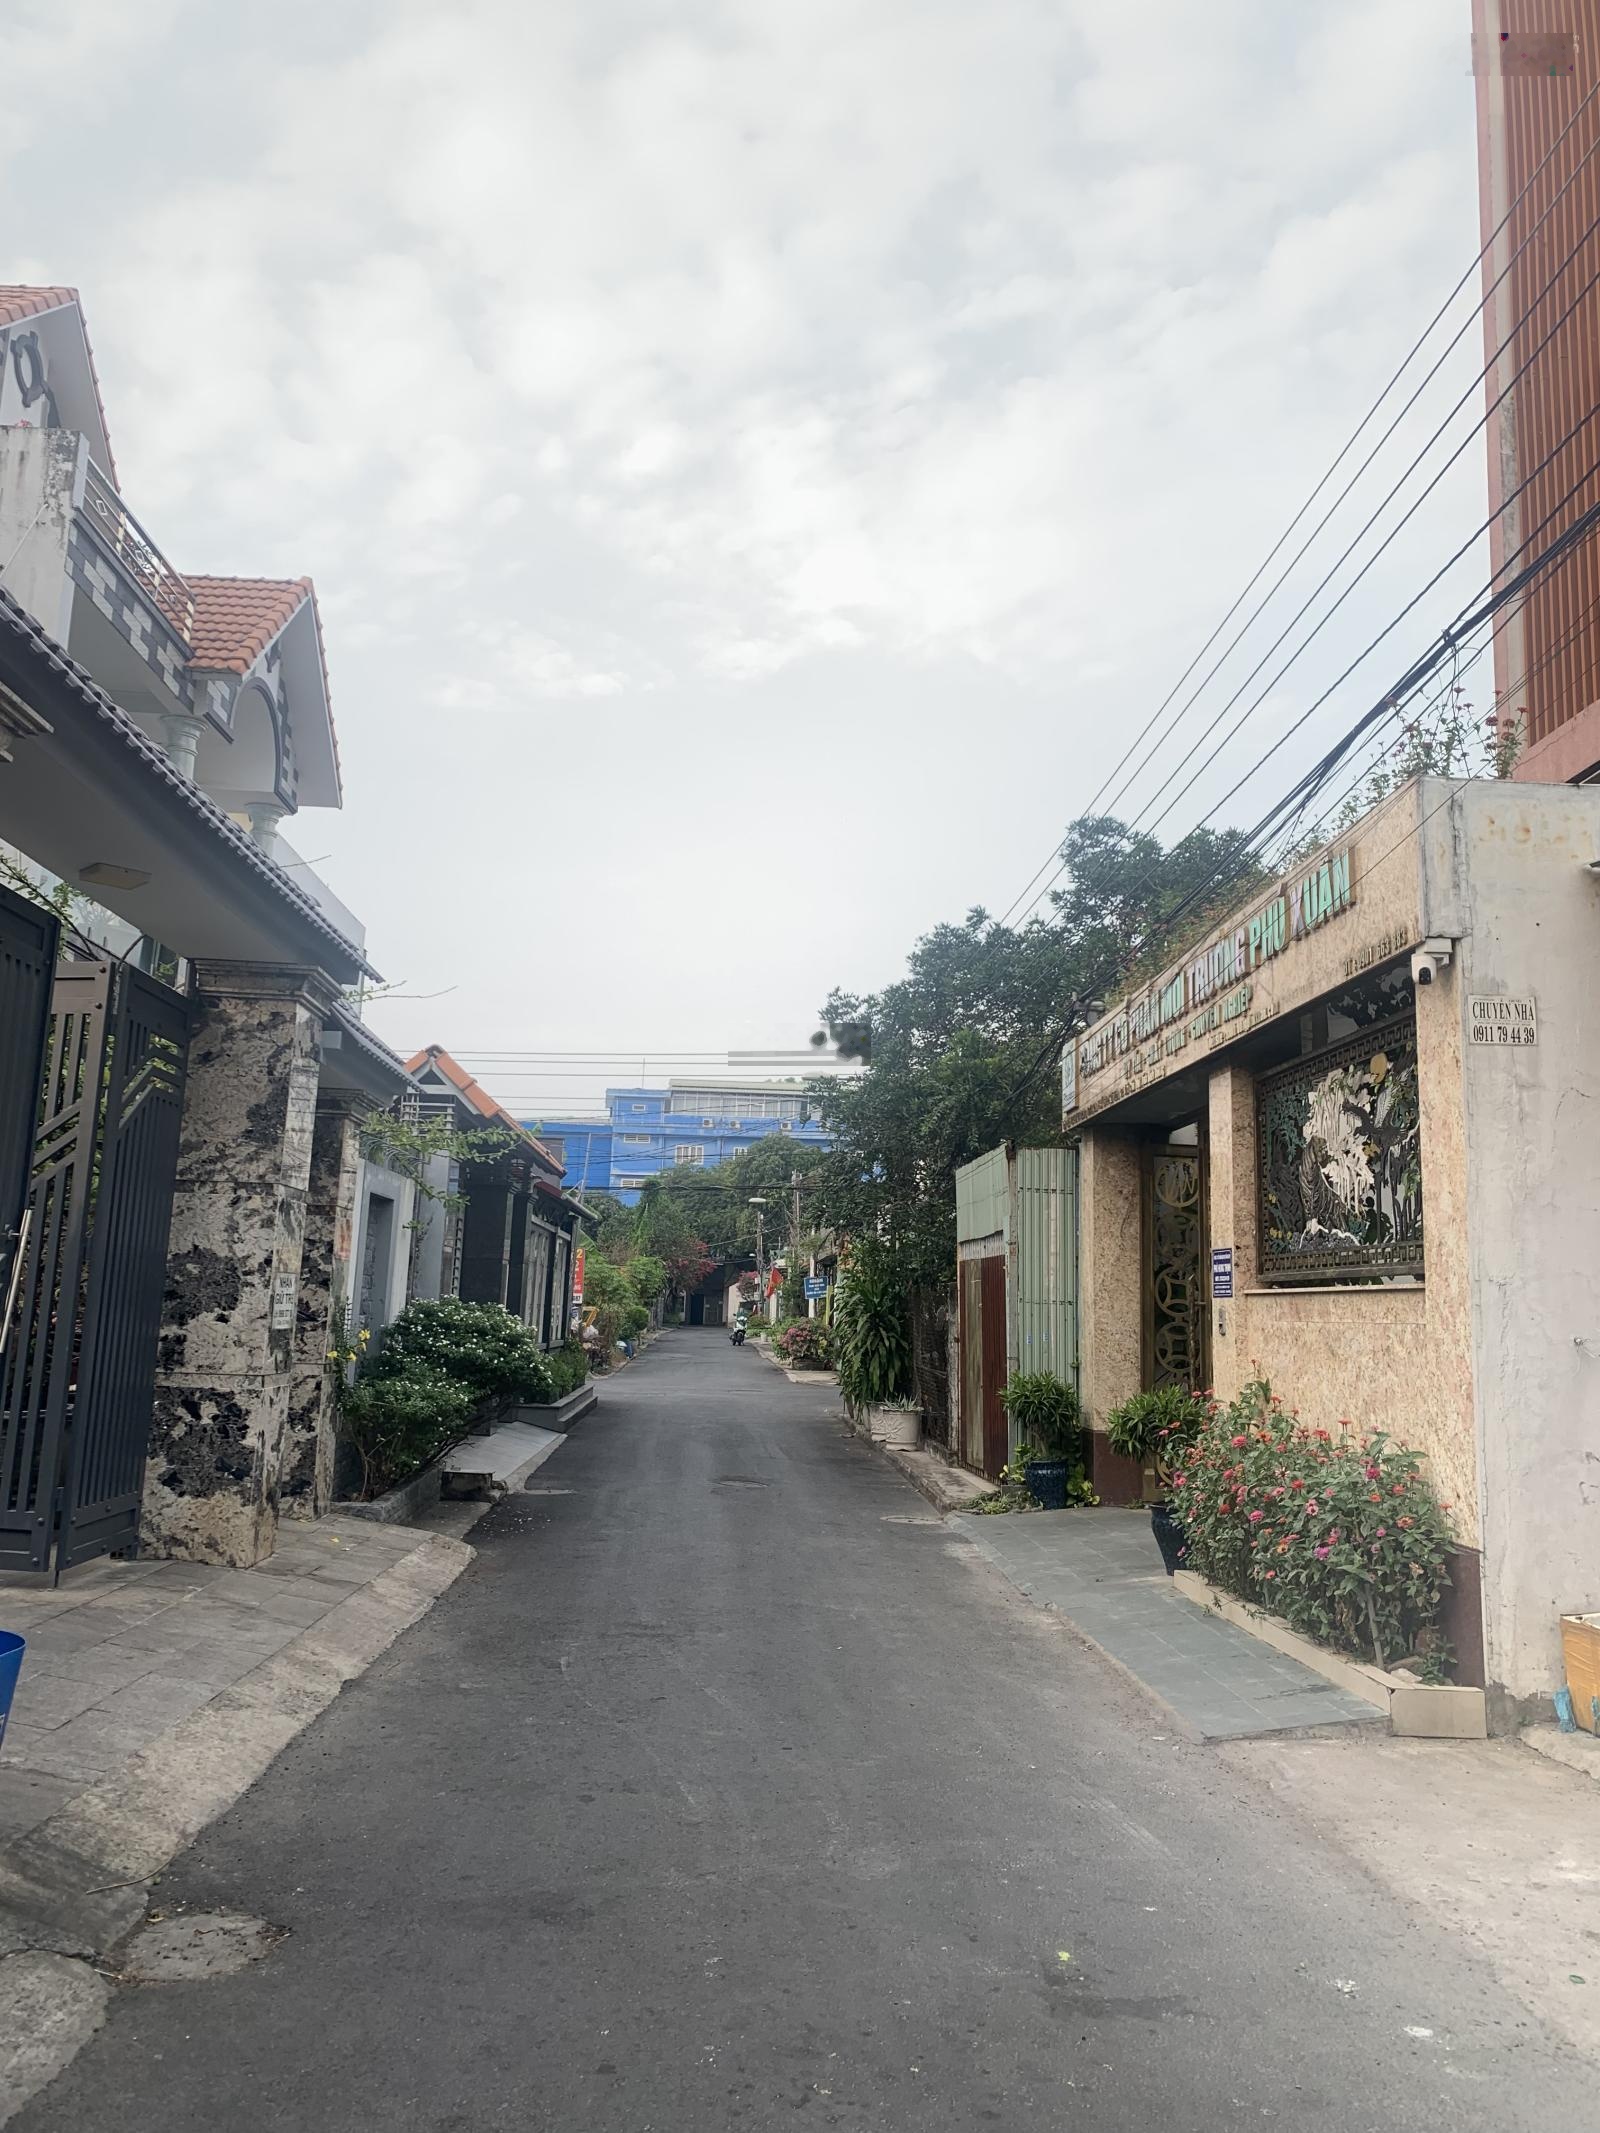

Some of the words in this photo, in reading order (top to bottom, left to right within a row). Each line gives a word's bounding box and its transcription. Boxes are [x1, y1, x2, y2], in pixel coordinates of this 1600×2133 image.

[1250, 884, 1286, 967] PHÚ
[1290, 848, 1350, 937] XUÂN
[1515, 999, 1535, 1021] NHÀ
[1473, 1025, 1495, 1042] 0911
[1497, 1025, 1508, 1043] 79
[1510, 1026, 1521, 1043] 44
[1523, 1027, 1535, 1044] 39
